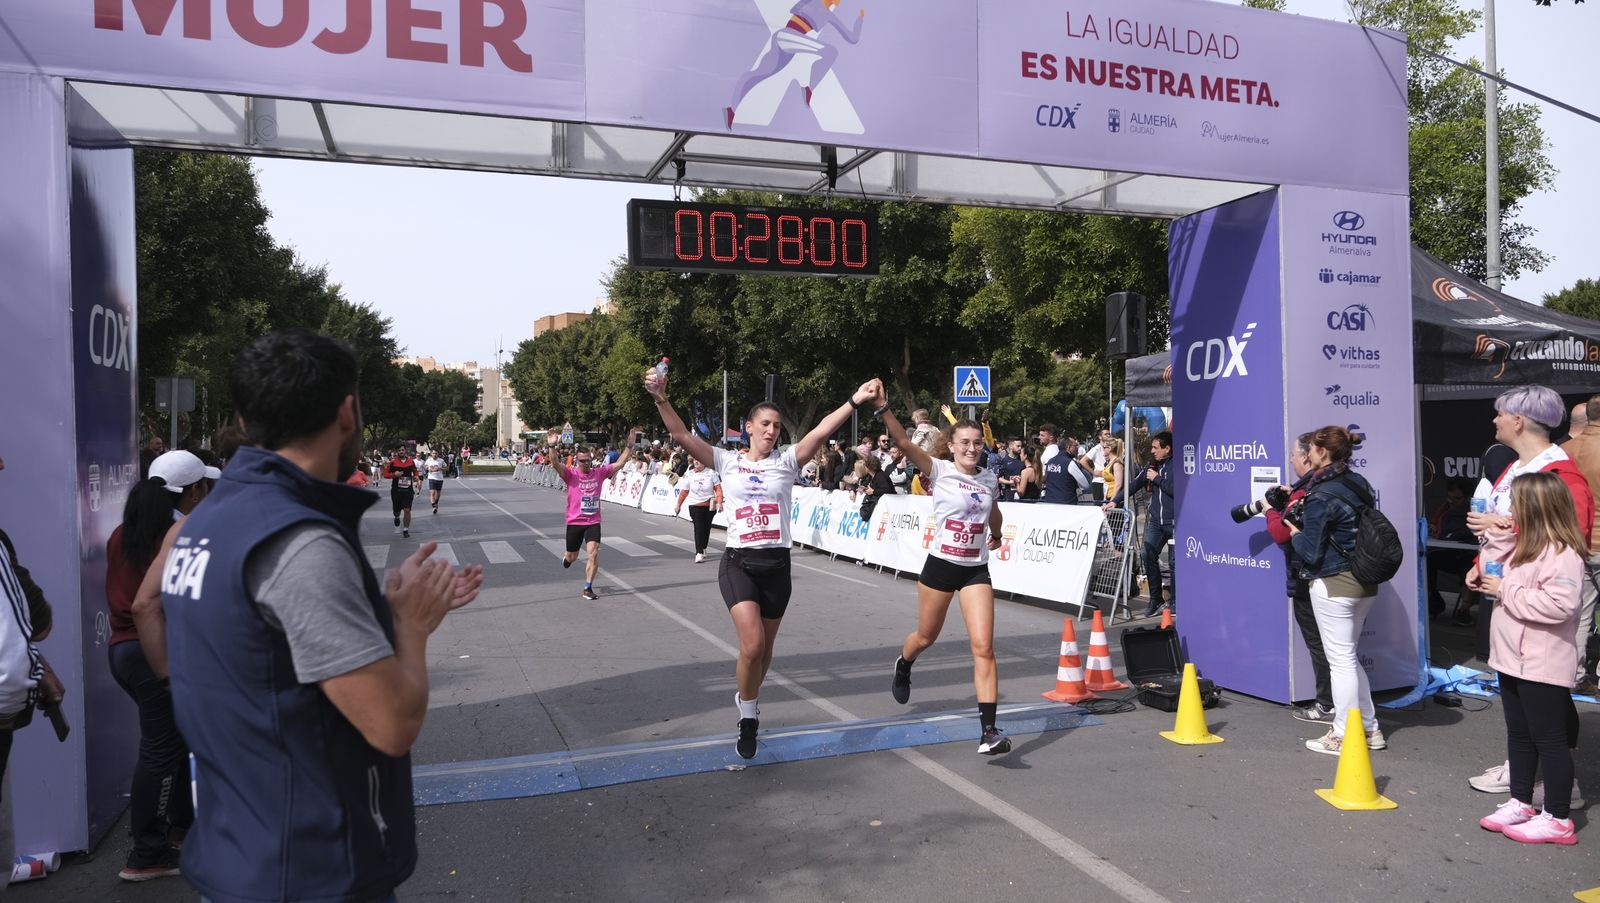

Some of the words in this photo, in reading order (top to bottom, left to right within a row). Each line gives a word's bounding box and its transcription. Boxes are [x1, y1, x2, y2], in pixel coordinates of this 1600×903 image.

[1066, 11, 1100, 41] LA
[1108, 17, 1240, 60] IGUALDAD
[1021, 51, 1059, 80] ES
[1065, 57, 1195, 98] NUESTRA
[1201, 76, 1279, 108] META.
[1036, 103, 1081, 129] CDX
[1130, 111, 1178, 129] ALMERÍA
[1130, 126, 1155, 135] CIUDAD
[675, 209, 867, 268] 00:28:00
[1322, 233, 1376, 246] HYUNDAI
[1337, 271, 1381, 285] cajamar
[89, 304, 131, 372] CDX
[1186, 323, 1257, 381] CDX
[1340, 346, 1380, 360] vithas
[1333, 391, 1380, 409] aqualia
[1205, 441, 1268, 461] ALMERÍA
[1205, 462, 1236, 473] CIUDAD
[746, 515, 770, 528] 990
[953, 532, 975, 545] 991
[1024, 526, 1089, 551] ALMERÍA
[1023, 548, 1055, 564] CIUDAD
